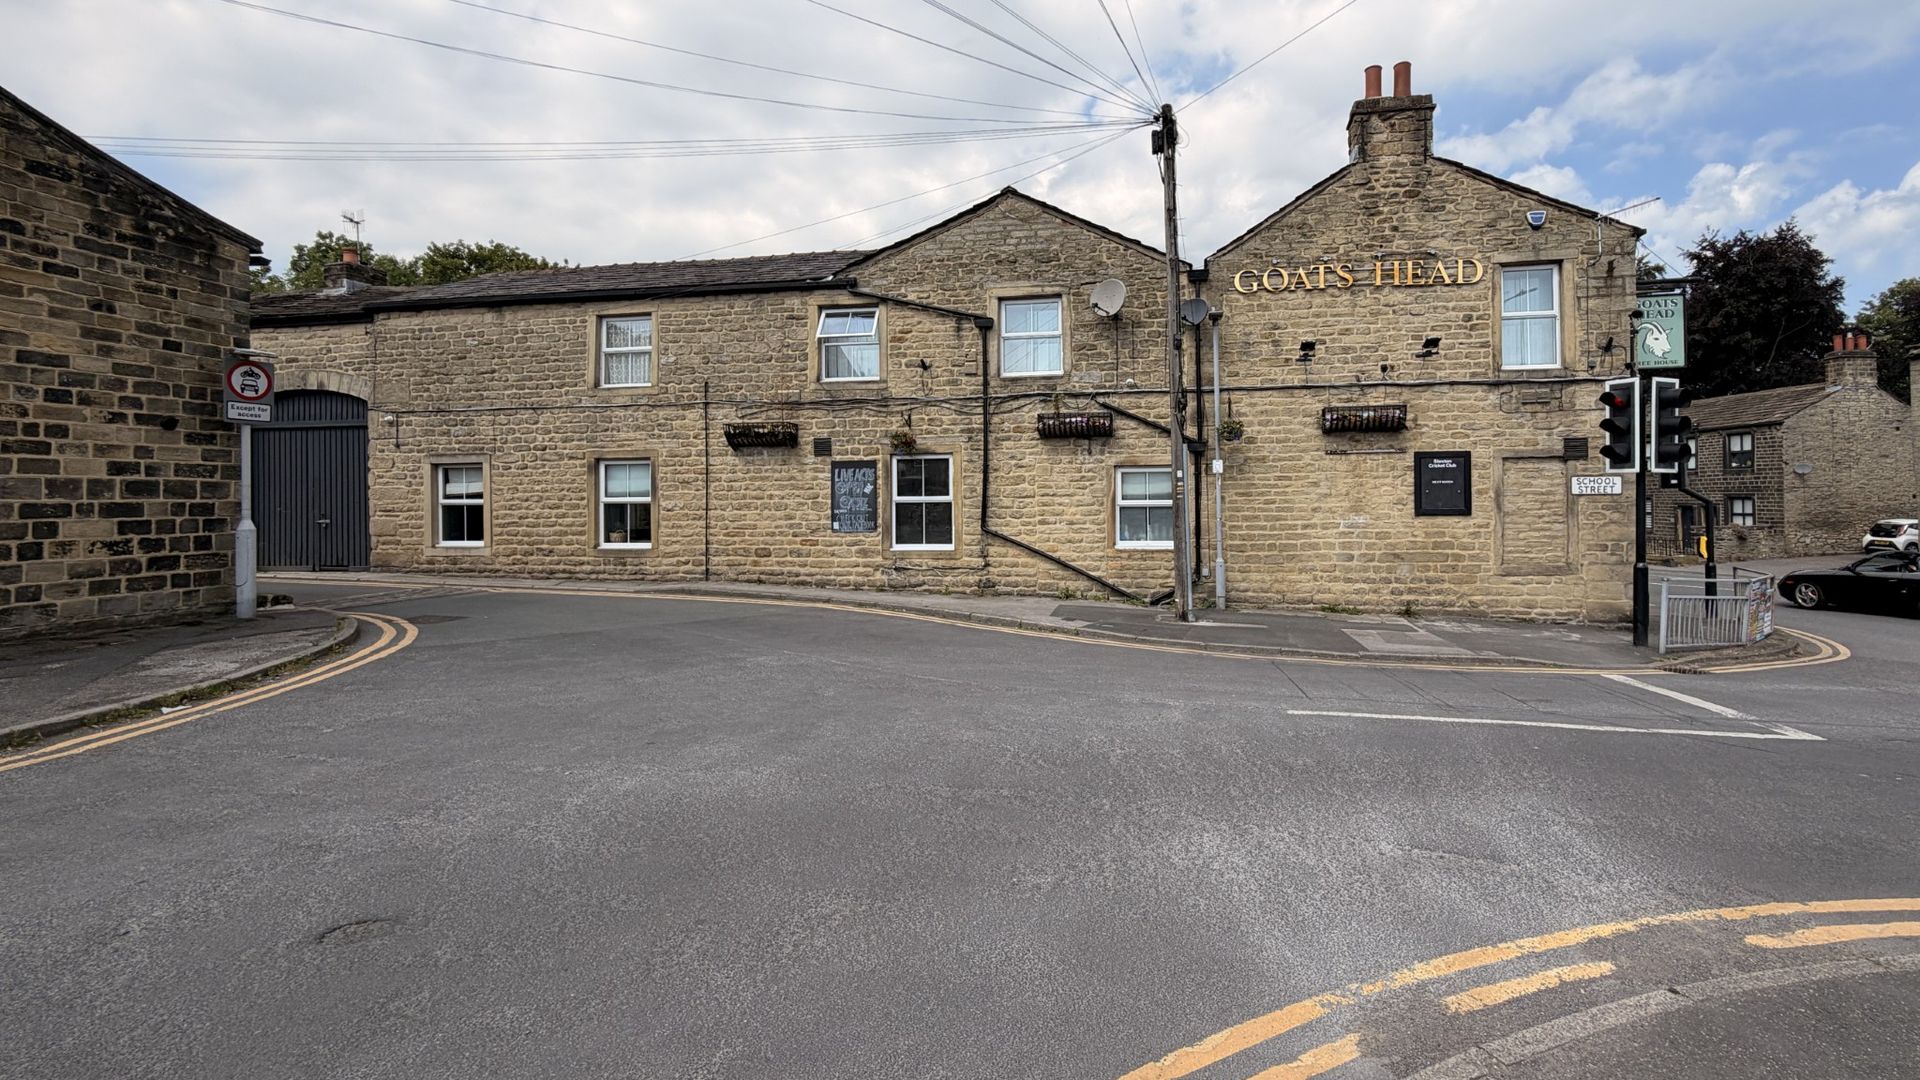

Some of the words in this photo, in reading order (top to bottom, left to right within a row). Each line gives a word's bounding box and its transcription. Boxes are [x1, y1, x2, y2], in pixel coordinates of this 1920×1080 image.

[1233, 263, 1354, 294] GOATS
[1374, 258, 1484, 286] HEAD
[1642, 309, 1675, 319] EAD
[231, 404, 256, 412] Except
[835, 468, 854, 481] LIVE
[1576, 477, 1617, 486] SCHOOL
[1578, 485, 1616, 494] STREET
